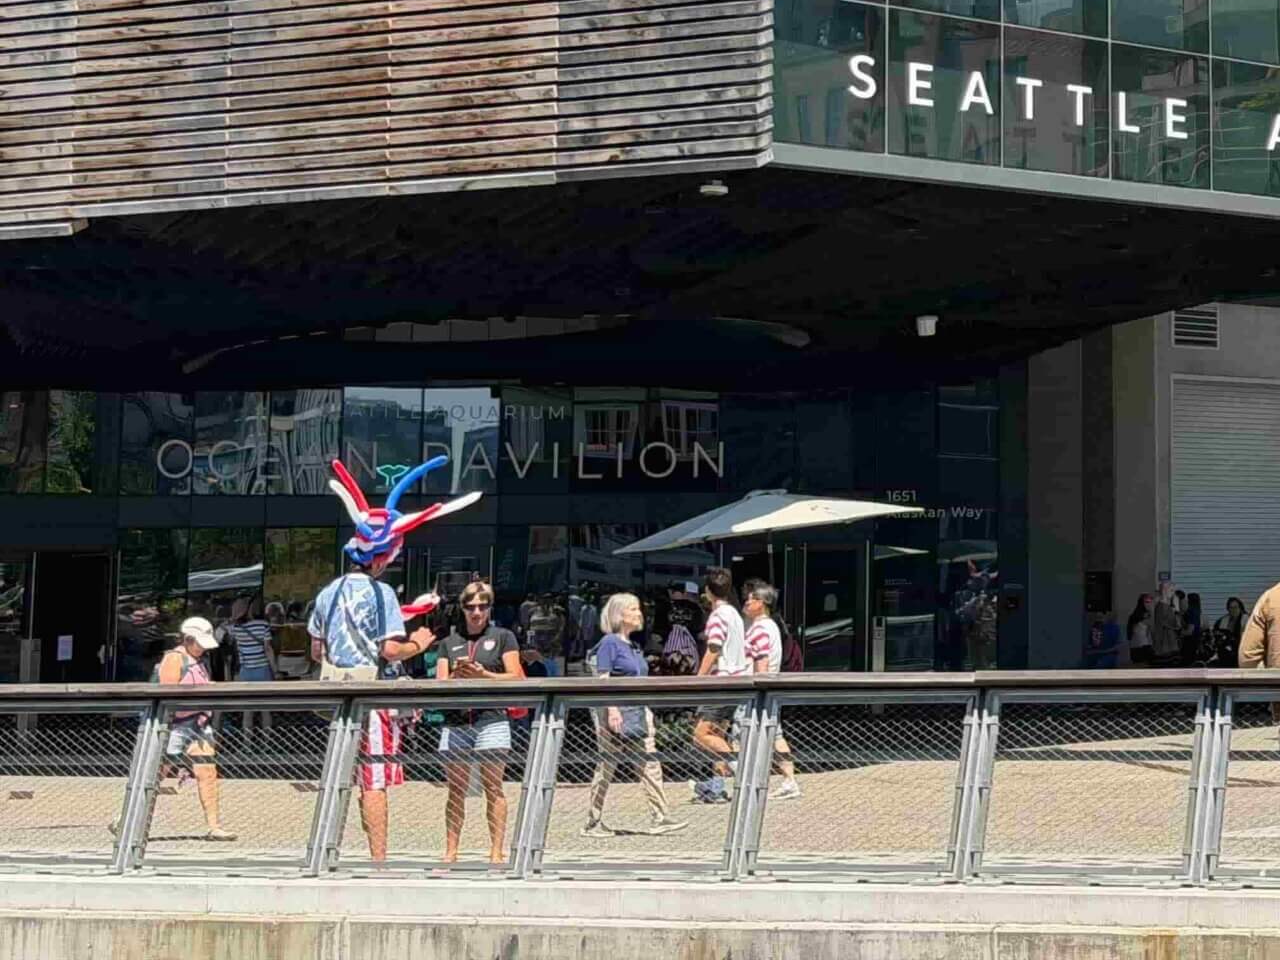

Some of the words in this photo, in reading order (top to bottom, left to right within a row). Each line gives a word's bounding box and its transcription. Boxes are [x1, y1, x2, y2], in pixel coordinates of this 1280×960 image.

[847, 55, 1188, 139] SEATTLE
[431, 405, 565, 420] AQUARIUM
[422, 441, 725, 480] PAVILION
[886, 490, 917, 502] 1651
[951, 506, 983, 520] Way
